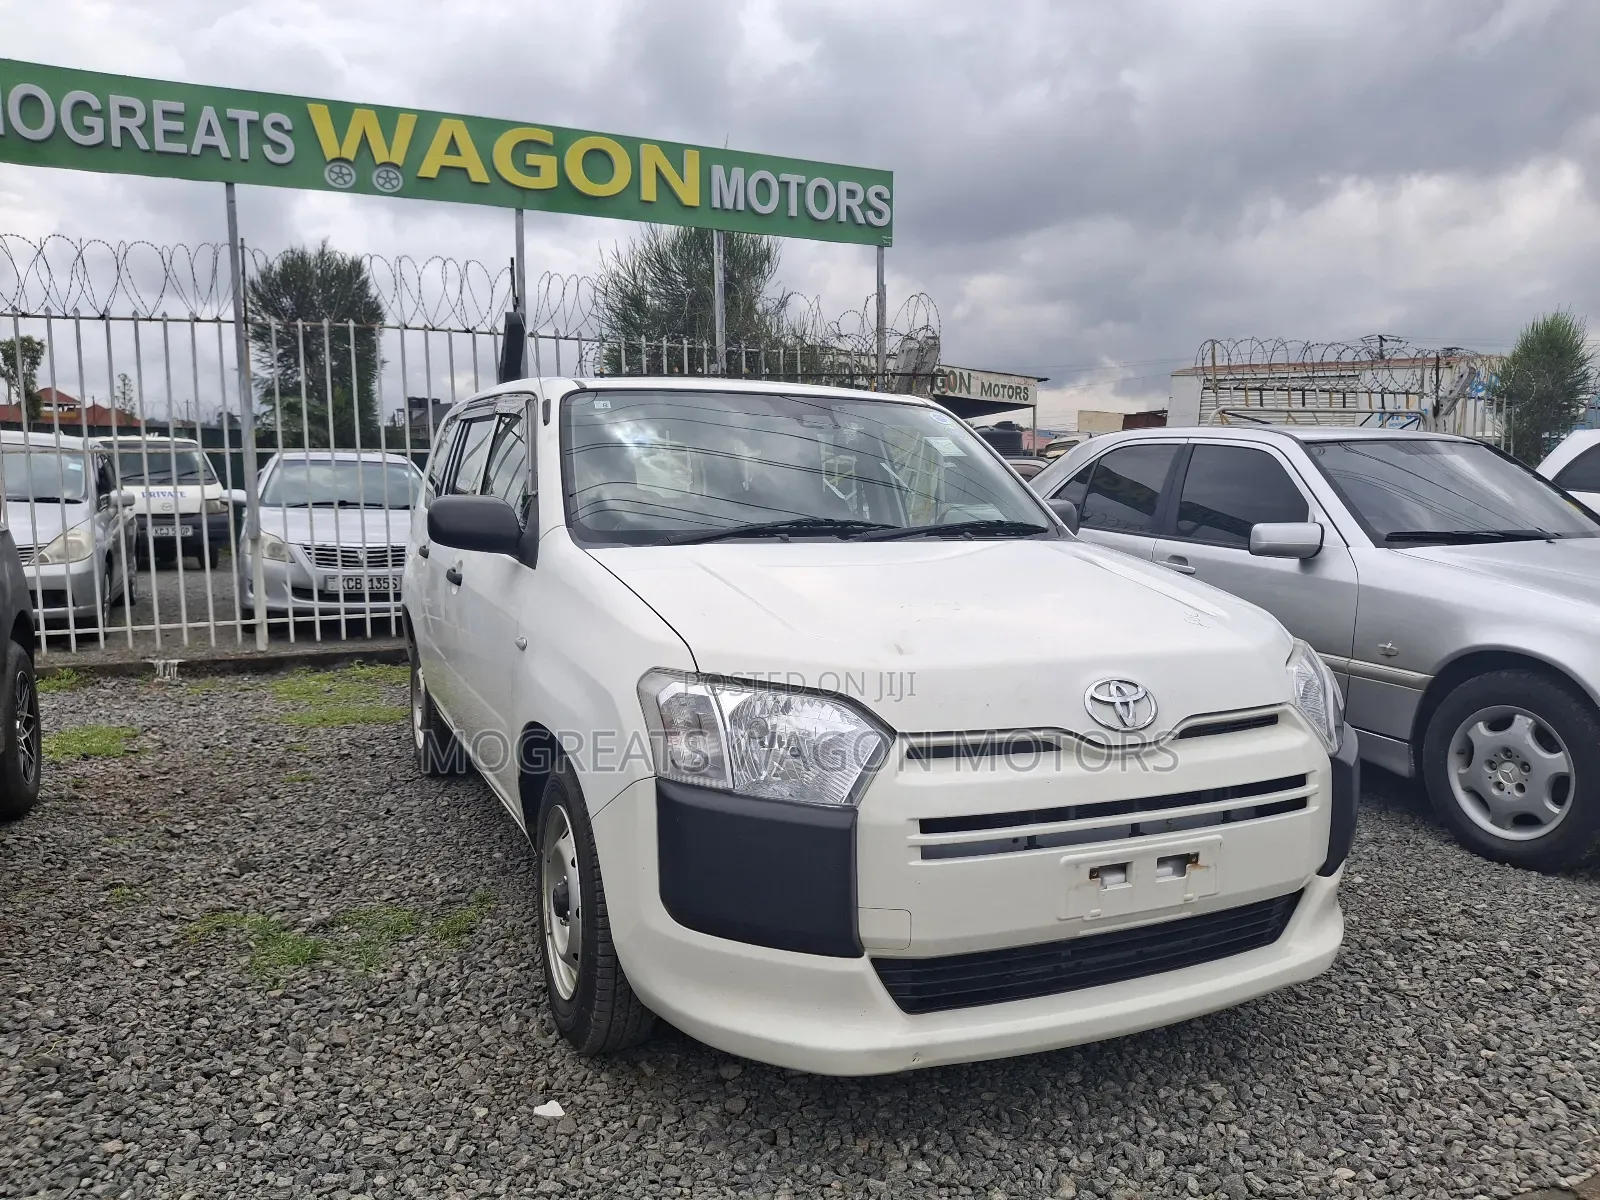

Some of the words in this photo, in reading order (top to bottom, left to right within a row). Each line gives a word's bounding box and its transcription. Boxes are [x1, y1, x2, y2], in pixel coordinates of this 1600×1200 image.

[0, 82, 295, 165] OGREATS
[307, 103, 701, 207] WAGON
[711, 164, 892, 227] MOTORS
[980, 381, 1029, 401] MOTORS
[141, 491, 187, 499] PRIVAE
